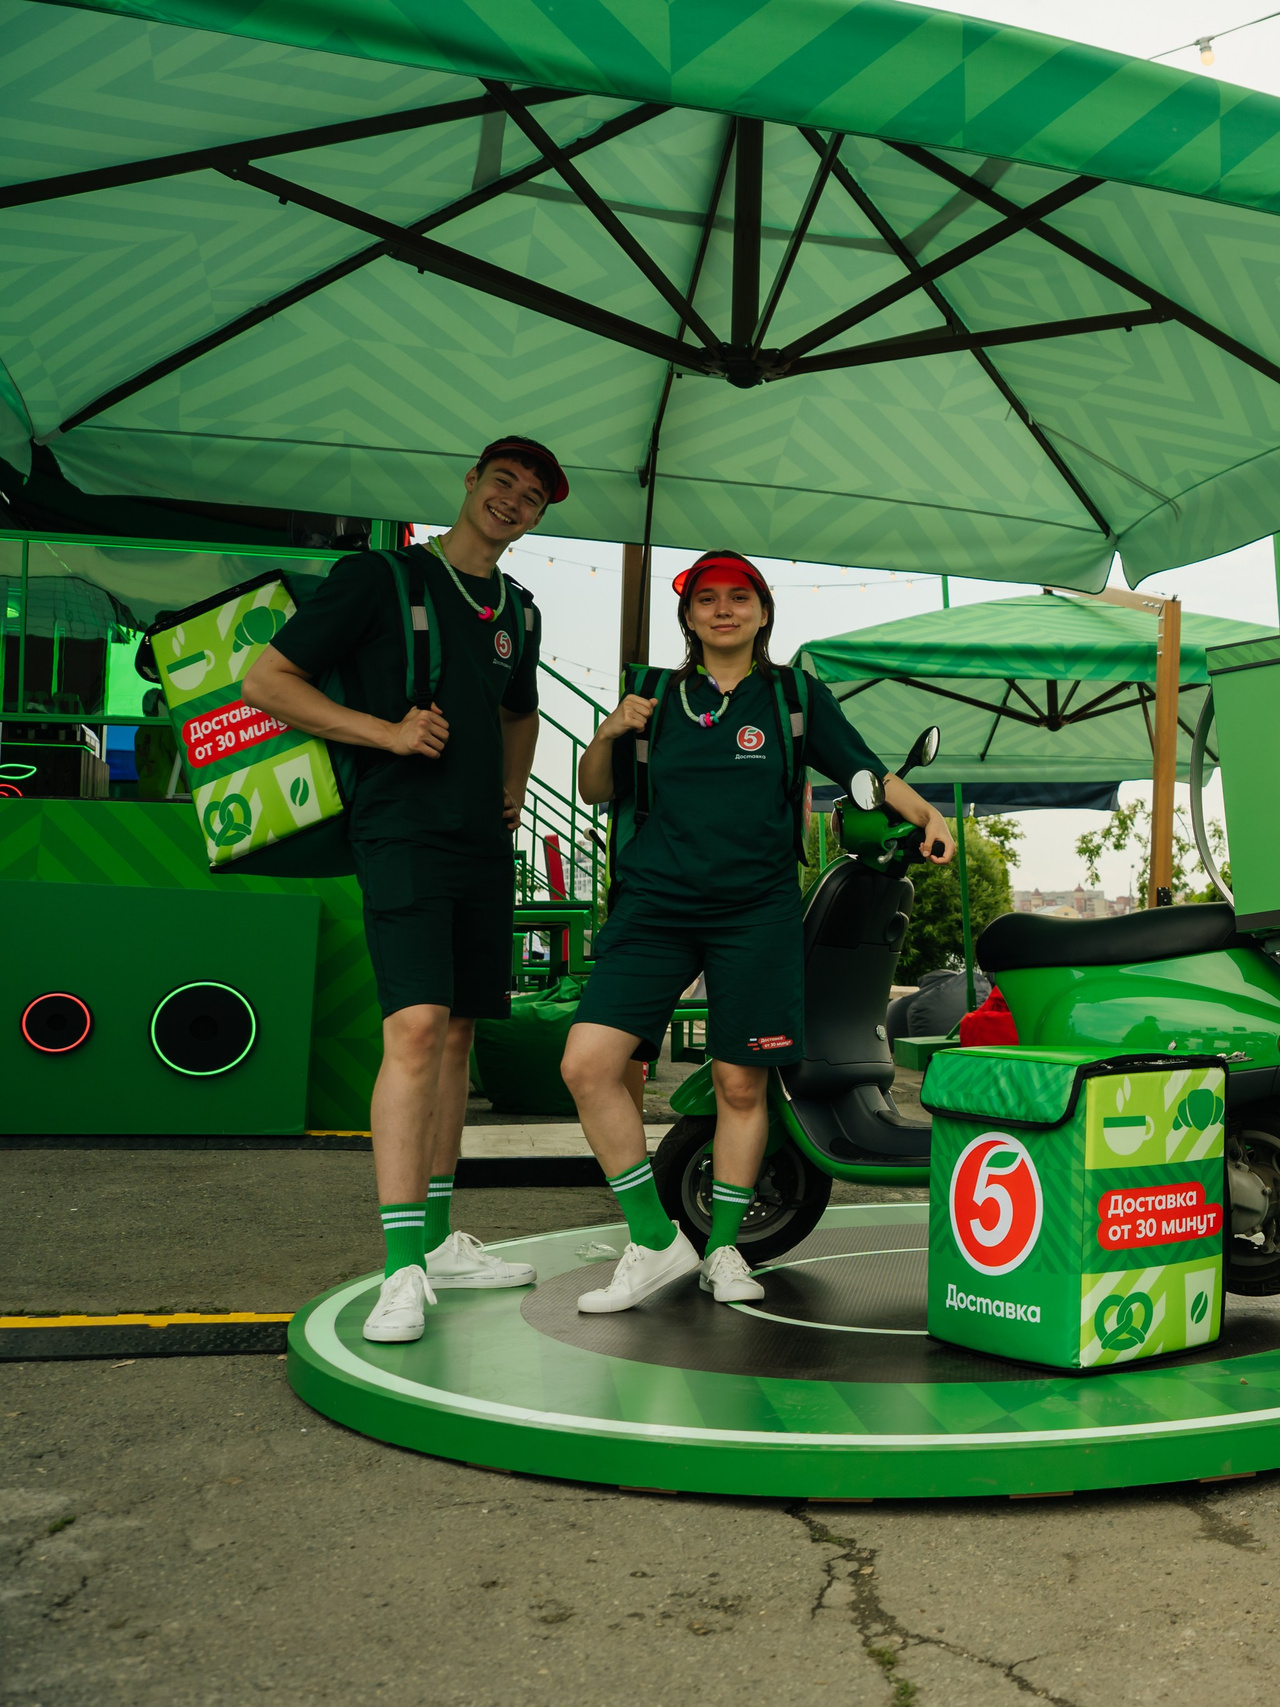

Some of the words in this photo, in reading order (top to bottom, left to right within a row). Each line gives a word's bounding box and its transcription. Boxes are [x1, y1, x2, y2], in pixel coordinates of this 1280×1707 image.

[194, 742, 213, 760] от
[215, 731, 236, 752] 30
[1107, 1190, 1197, 1218] Доставка
[1108, 1224, 1132, 1241] от
[1135, 1218, 1157, 1239] 30
[1161, 1213, 1217, 1235] минут
[945, 1283, 1042, 1323] Доставка
